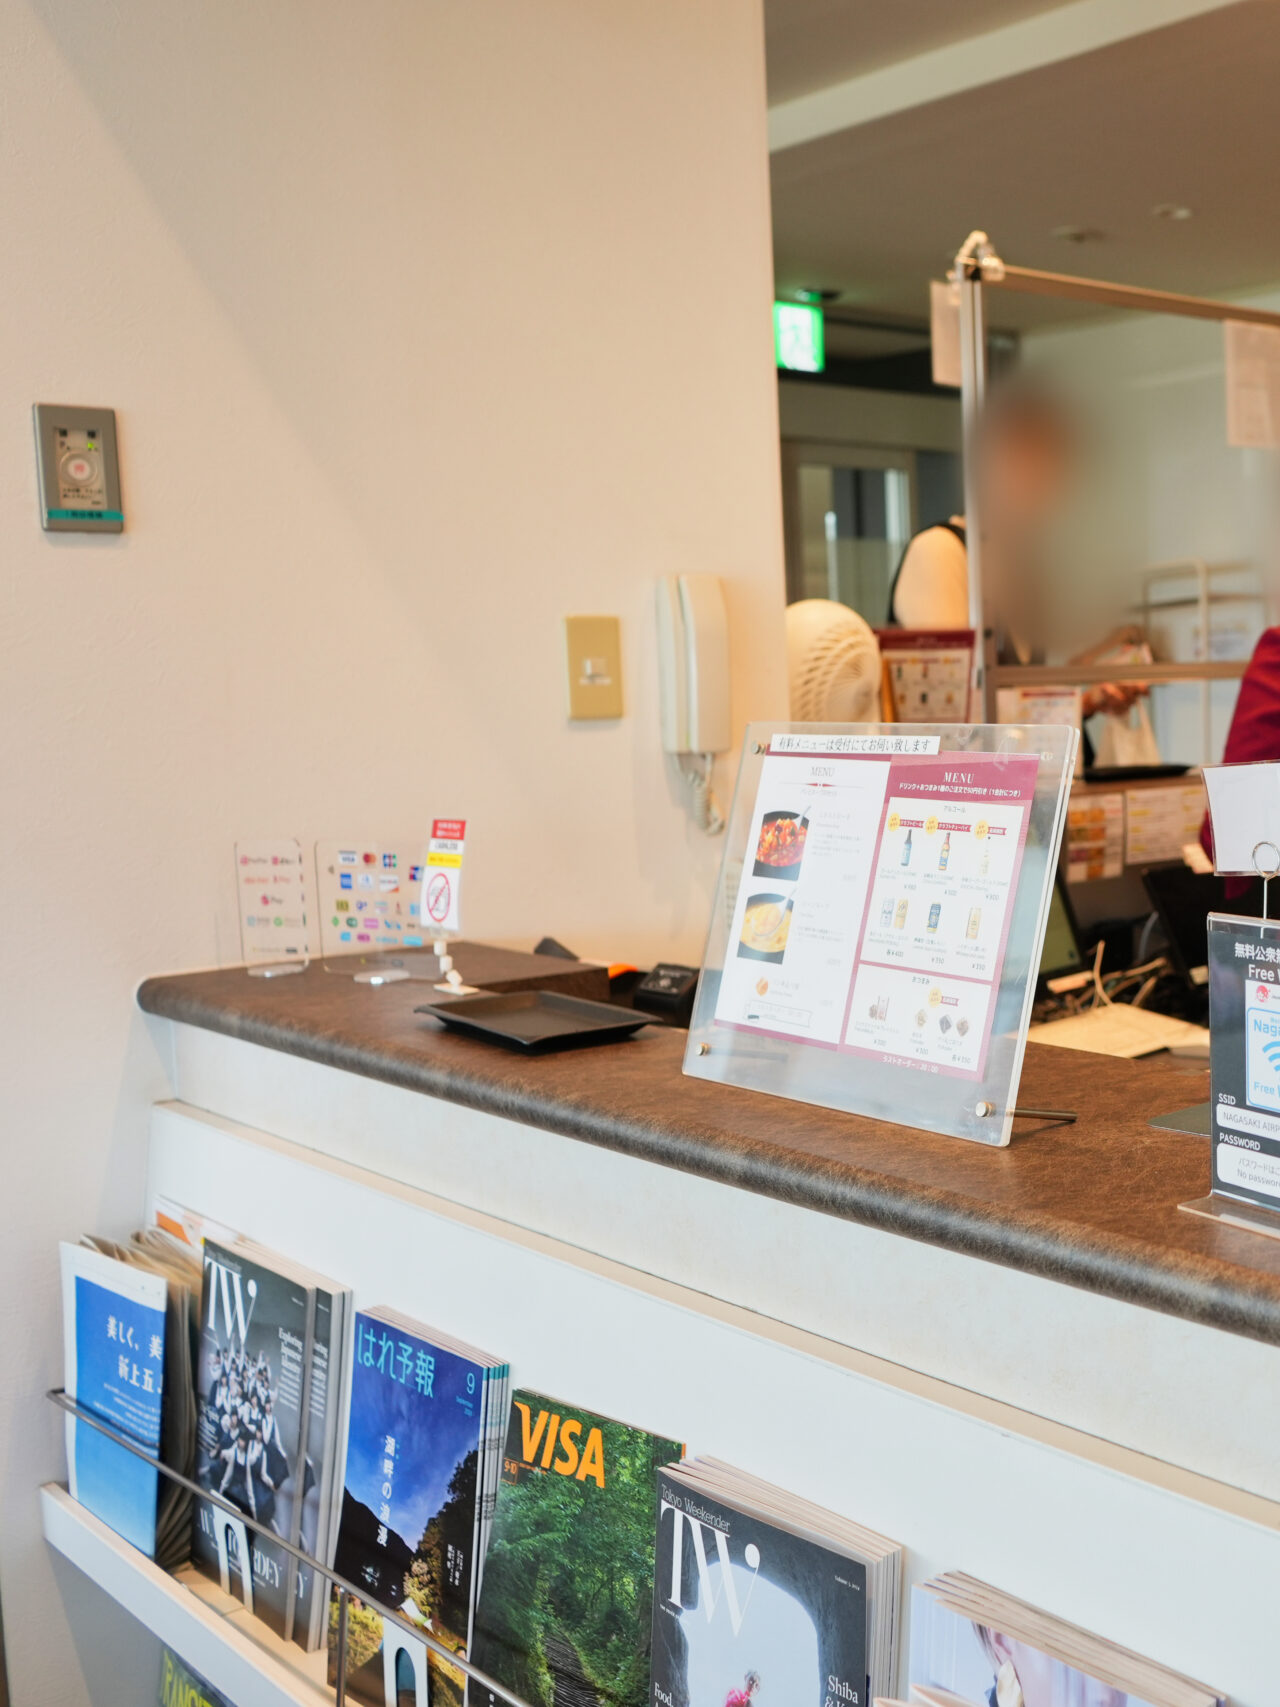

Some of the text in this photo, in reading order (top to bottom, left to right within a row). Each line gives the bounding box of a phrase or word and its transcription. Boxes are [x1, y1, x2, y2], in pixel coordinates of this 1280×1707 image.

[810, 766, 835, 778] MENU
[943, 772, 975, 783] MENU
[1248, 964, 1275, 982] Free
[1254, 1081, 1275, 1096] Free
[1218, 1093, 1236, 1106] SSID
[1223, 1111, 1261, 1128] NAGASAKI
[1219, 1132, 1261, 1151] PASSWORD
[1237, 1168, 1247, 1179] No
[357, 1323, 435, 1399] はれ予報
[118, 1354, 163, 1395] 新上五
[466, 1372, 476, 1396] 9
[513, 1400, 606, 1489] VISA
[661, 1483, 731, 1532] Tokyo Weekender
[660, 1499, 761, 1638] TW
[828, 1675, 858, 1705] Shiba
